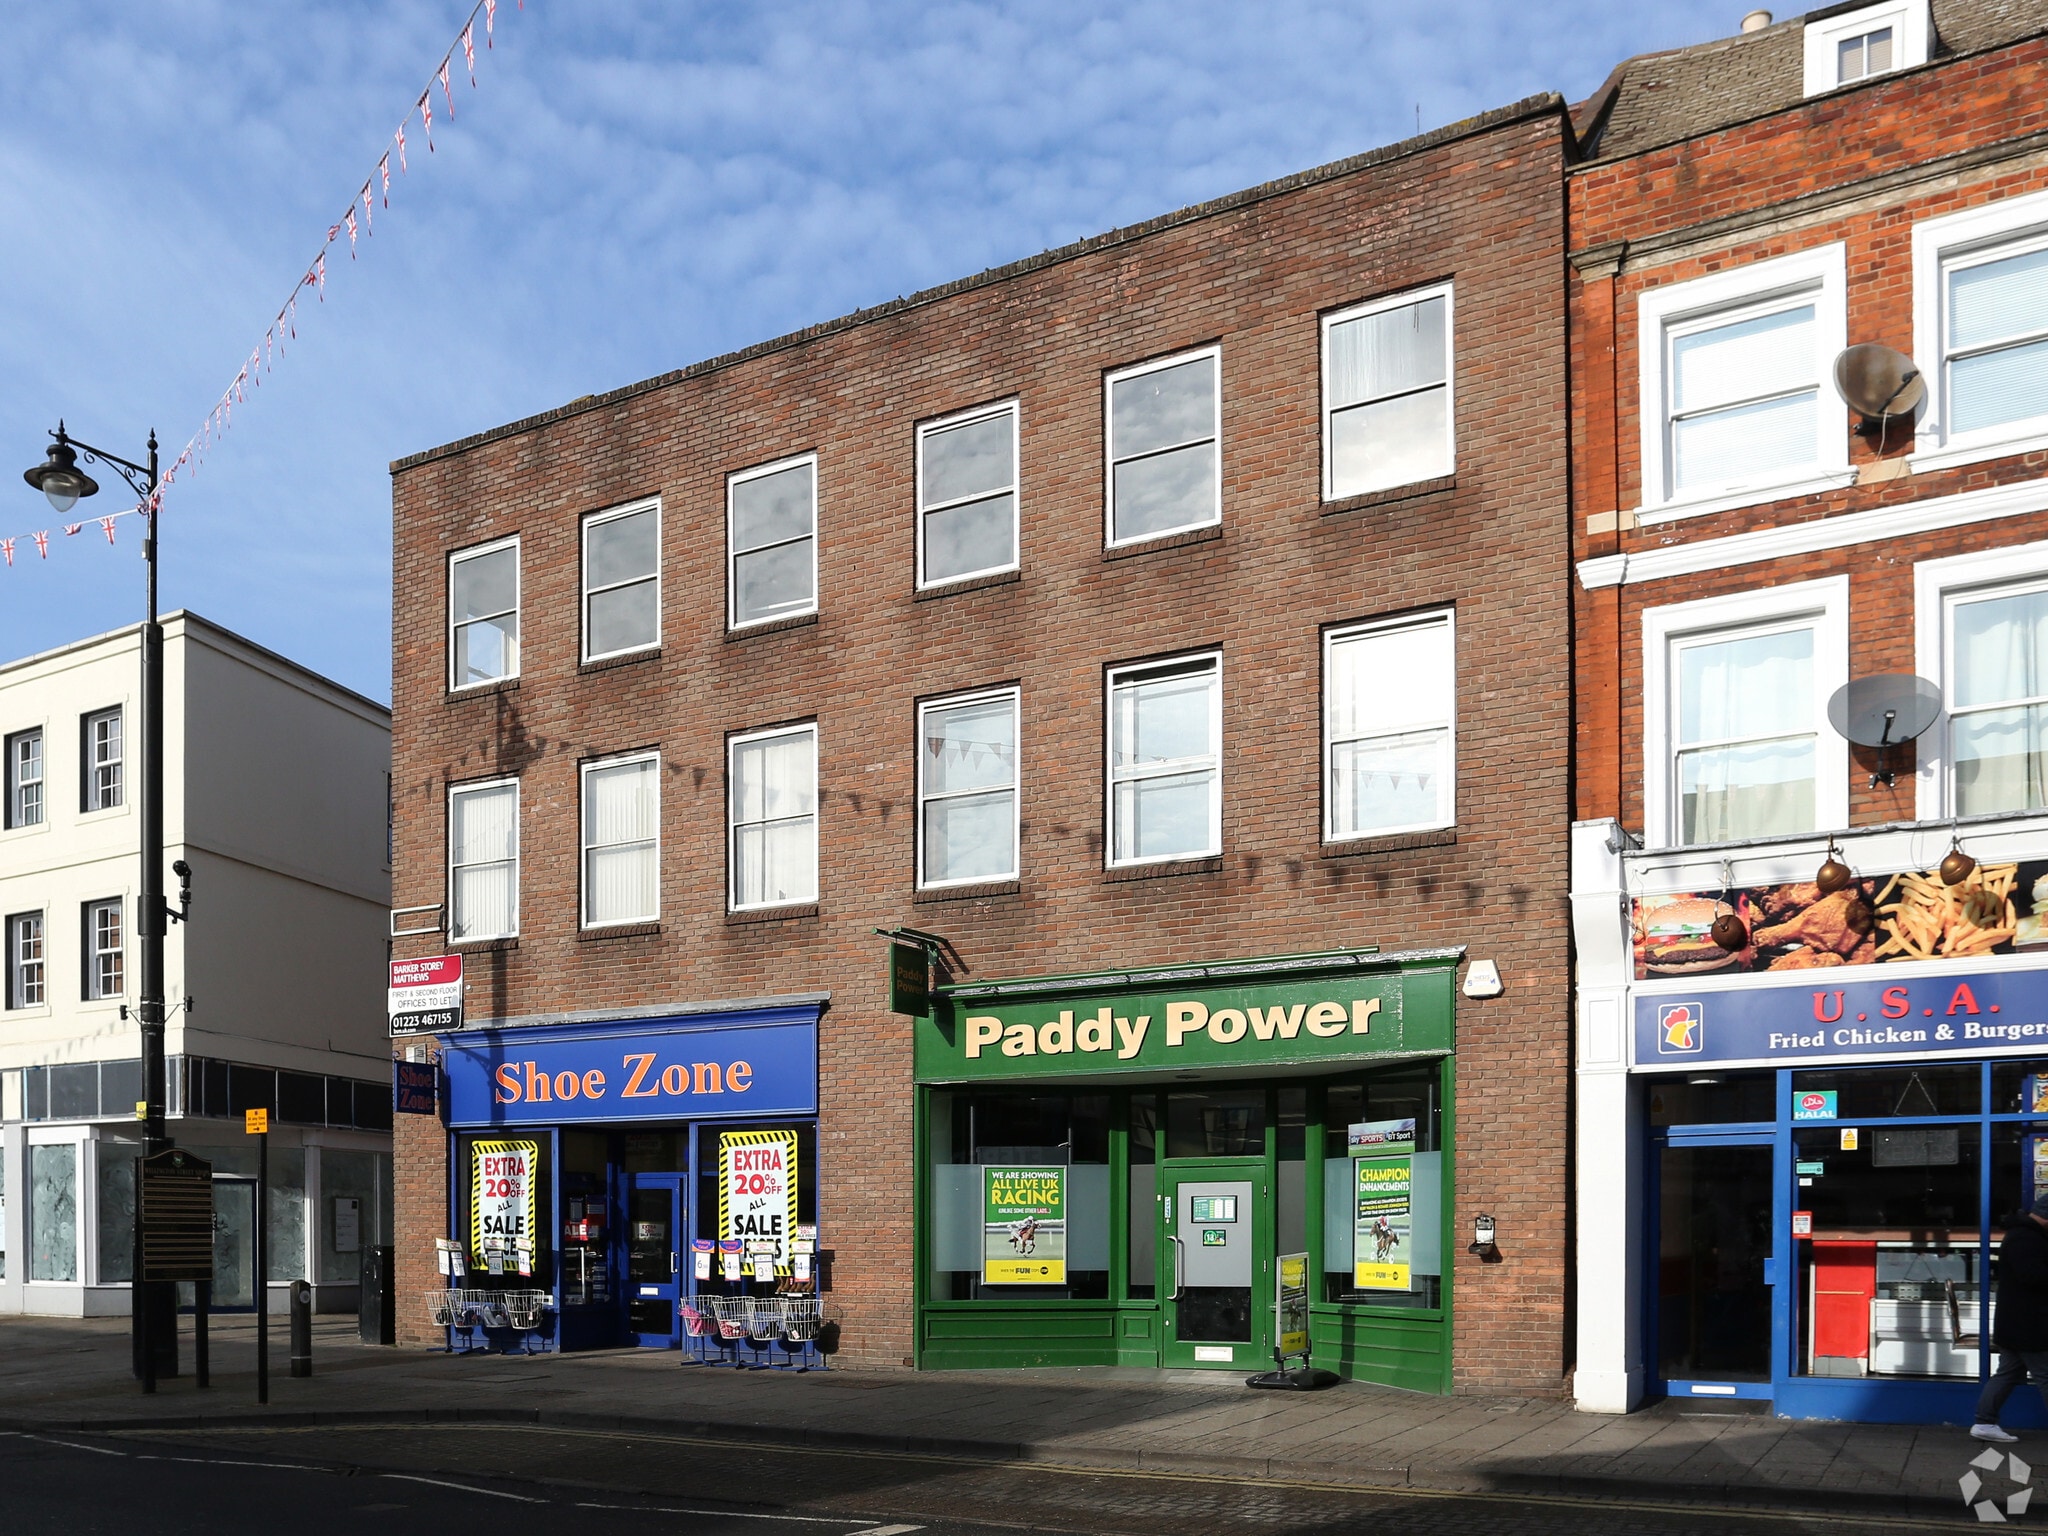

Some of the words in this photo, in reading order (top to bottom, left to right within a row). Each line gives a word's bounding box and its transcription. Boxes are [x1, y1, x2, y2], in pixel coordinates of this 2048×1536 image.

[393, 964, 419, 975] BARKER
[420, 961, 444, 972] STOREY
[896, 966, 924, 984] Paddy
[393, 972, 430, 984] MATTHEWS
[392, 990, 408, 998] FIRST
[416, 988, 438, 997] SECOND
[440, 986, 458, 995] FLOOR
[896, 980, 924, 994] Power
[398, 998, 426, 1008] OFFICES
[429, 997, 438, 1006] TO
[440, 996, 452, 1005] LET
[393, 1015, 420, 1028] 01223
[422, 1012, 452, 1026] 467155
[965, 1007, 1151, 1059] Paddy
[1166, 998, 1381, 1047] Power
[1769, 1030, 1825, 1049] Fried
[1833, 1026, 1927, 1046] Chicken
[1935, 1023, 1956, 1041] &
[400, 1066, 432, 1088] Shoe
[495, 1061, 607, 1104] Shoe
[620, 1053, 753, 1098] Zone
[400, 1088, 432, 1110] Zone
[1794, 1110, 1836, 1119] HALAL
[1350, 1136, 1360, 1145] sky
[1360, 1133, 1383, 1143] SPORTS
[1396, 1130, 1411, 1140] Sport
[484, 1157, 526, 1176] EXTRA
[734, 1149, 782, 1171] EXTRA
[1360, 1168, 1410, 1182] CHAMPION
[764, 1186, 782, 1195] OFF
[992, 1180, 1012, 1189] ALL
[1014, 1180, 1038, 1189] LIVE
[1042, 1180, 1058, 1189] UK
[1360, 1182, 1410, 1192] ENHANCEMENTS
[510, 1190, 525, 1198] OFF
[992, 1190, 1058, 1205] RACING
[497, 1200, 512, 1213] ALL
[749, 1198, 766, 1212] ALL
[484, 1216, 524, 1234] SALE
[564, 1224, 586, 1236] ALE
[734, 1214, 782, 1236] SALE
